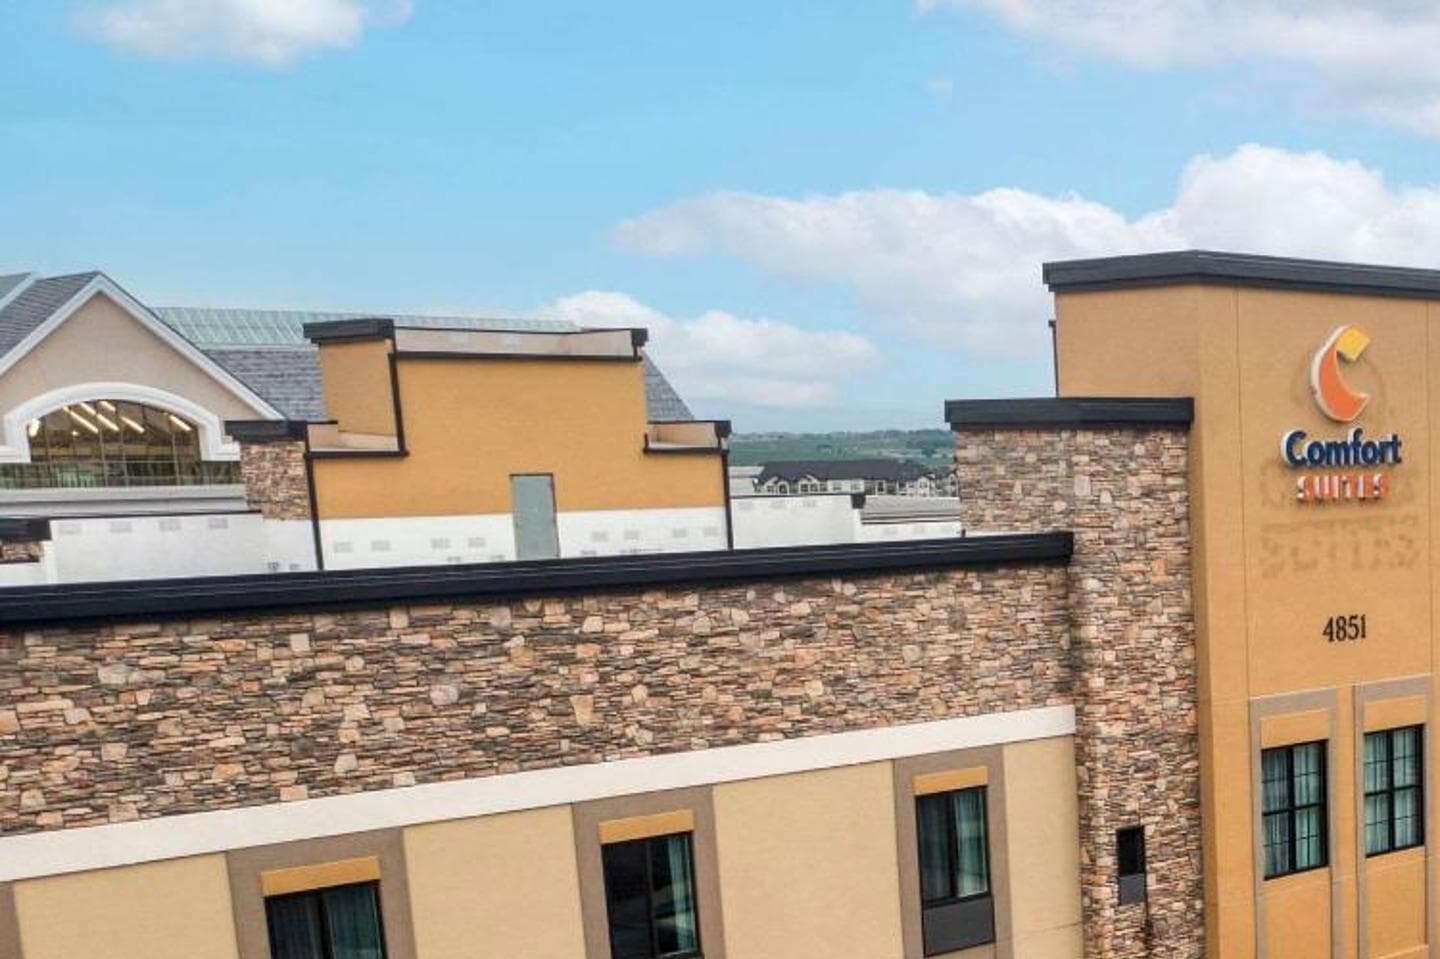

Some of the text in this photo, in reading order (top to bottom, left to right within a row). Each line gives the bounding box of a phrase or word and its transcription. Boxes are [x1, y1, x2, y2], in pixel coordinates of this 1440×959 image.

[1281, 428, 1402, 467] Comfort
[1297, 473, 1389, 501] SUITES
[1322, 614, 1366, 642] 4851
